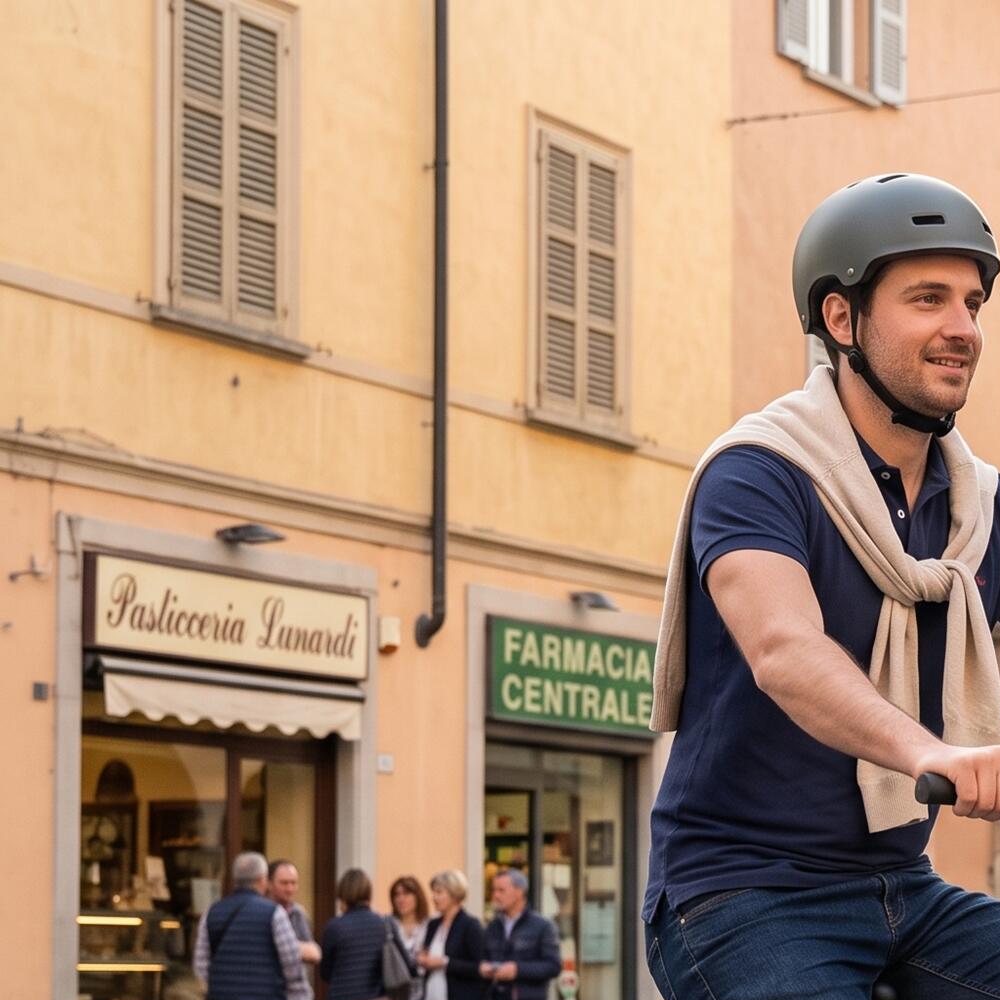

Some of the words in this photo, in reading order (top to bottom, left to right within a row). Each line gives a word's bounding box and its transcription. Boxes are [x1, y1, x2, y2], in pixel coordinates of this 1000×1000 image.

[106, 572, 246, 645] Pasticceria
[256, 595, 359, 659] Lunardi
[503, 627, 653, 684] FARMACIA
[501, 673, 653, 727] CENTRALE
